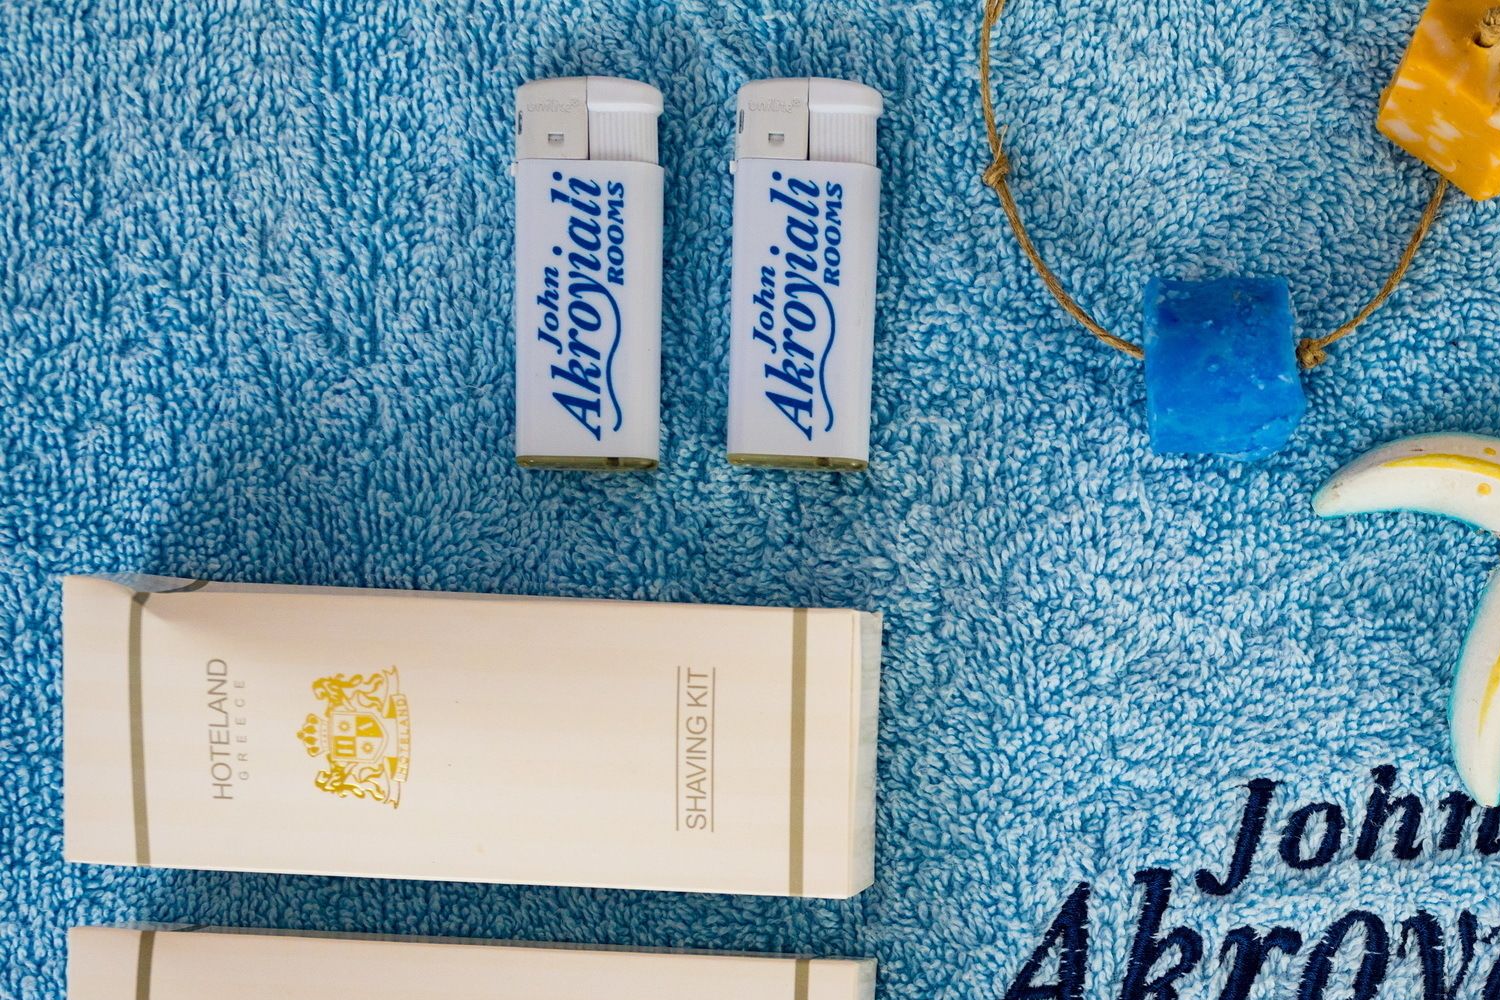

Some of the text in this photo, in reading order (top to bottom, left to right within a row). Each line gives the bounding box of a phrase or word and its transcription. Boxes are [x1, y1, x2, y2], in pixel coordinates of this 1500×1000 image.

[607, 180, 625, 287] ROOMS
[824, 180, 843, 287] ROOMS
[537, 266, 562, 355] John
[550, 171, 622, 441] Akroyiali
[753, 266, 778, 353] John
[765, 170, 835, 441] Akroyiali
[206, 658, 233, 800] HOTELAND
[233, 680, 249, 781] GREECE
[686, 667, 709, 830] SHAVING KIT
